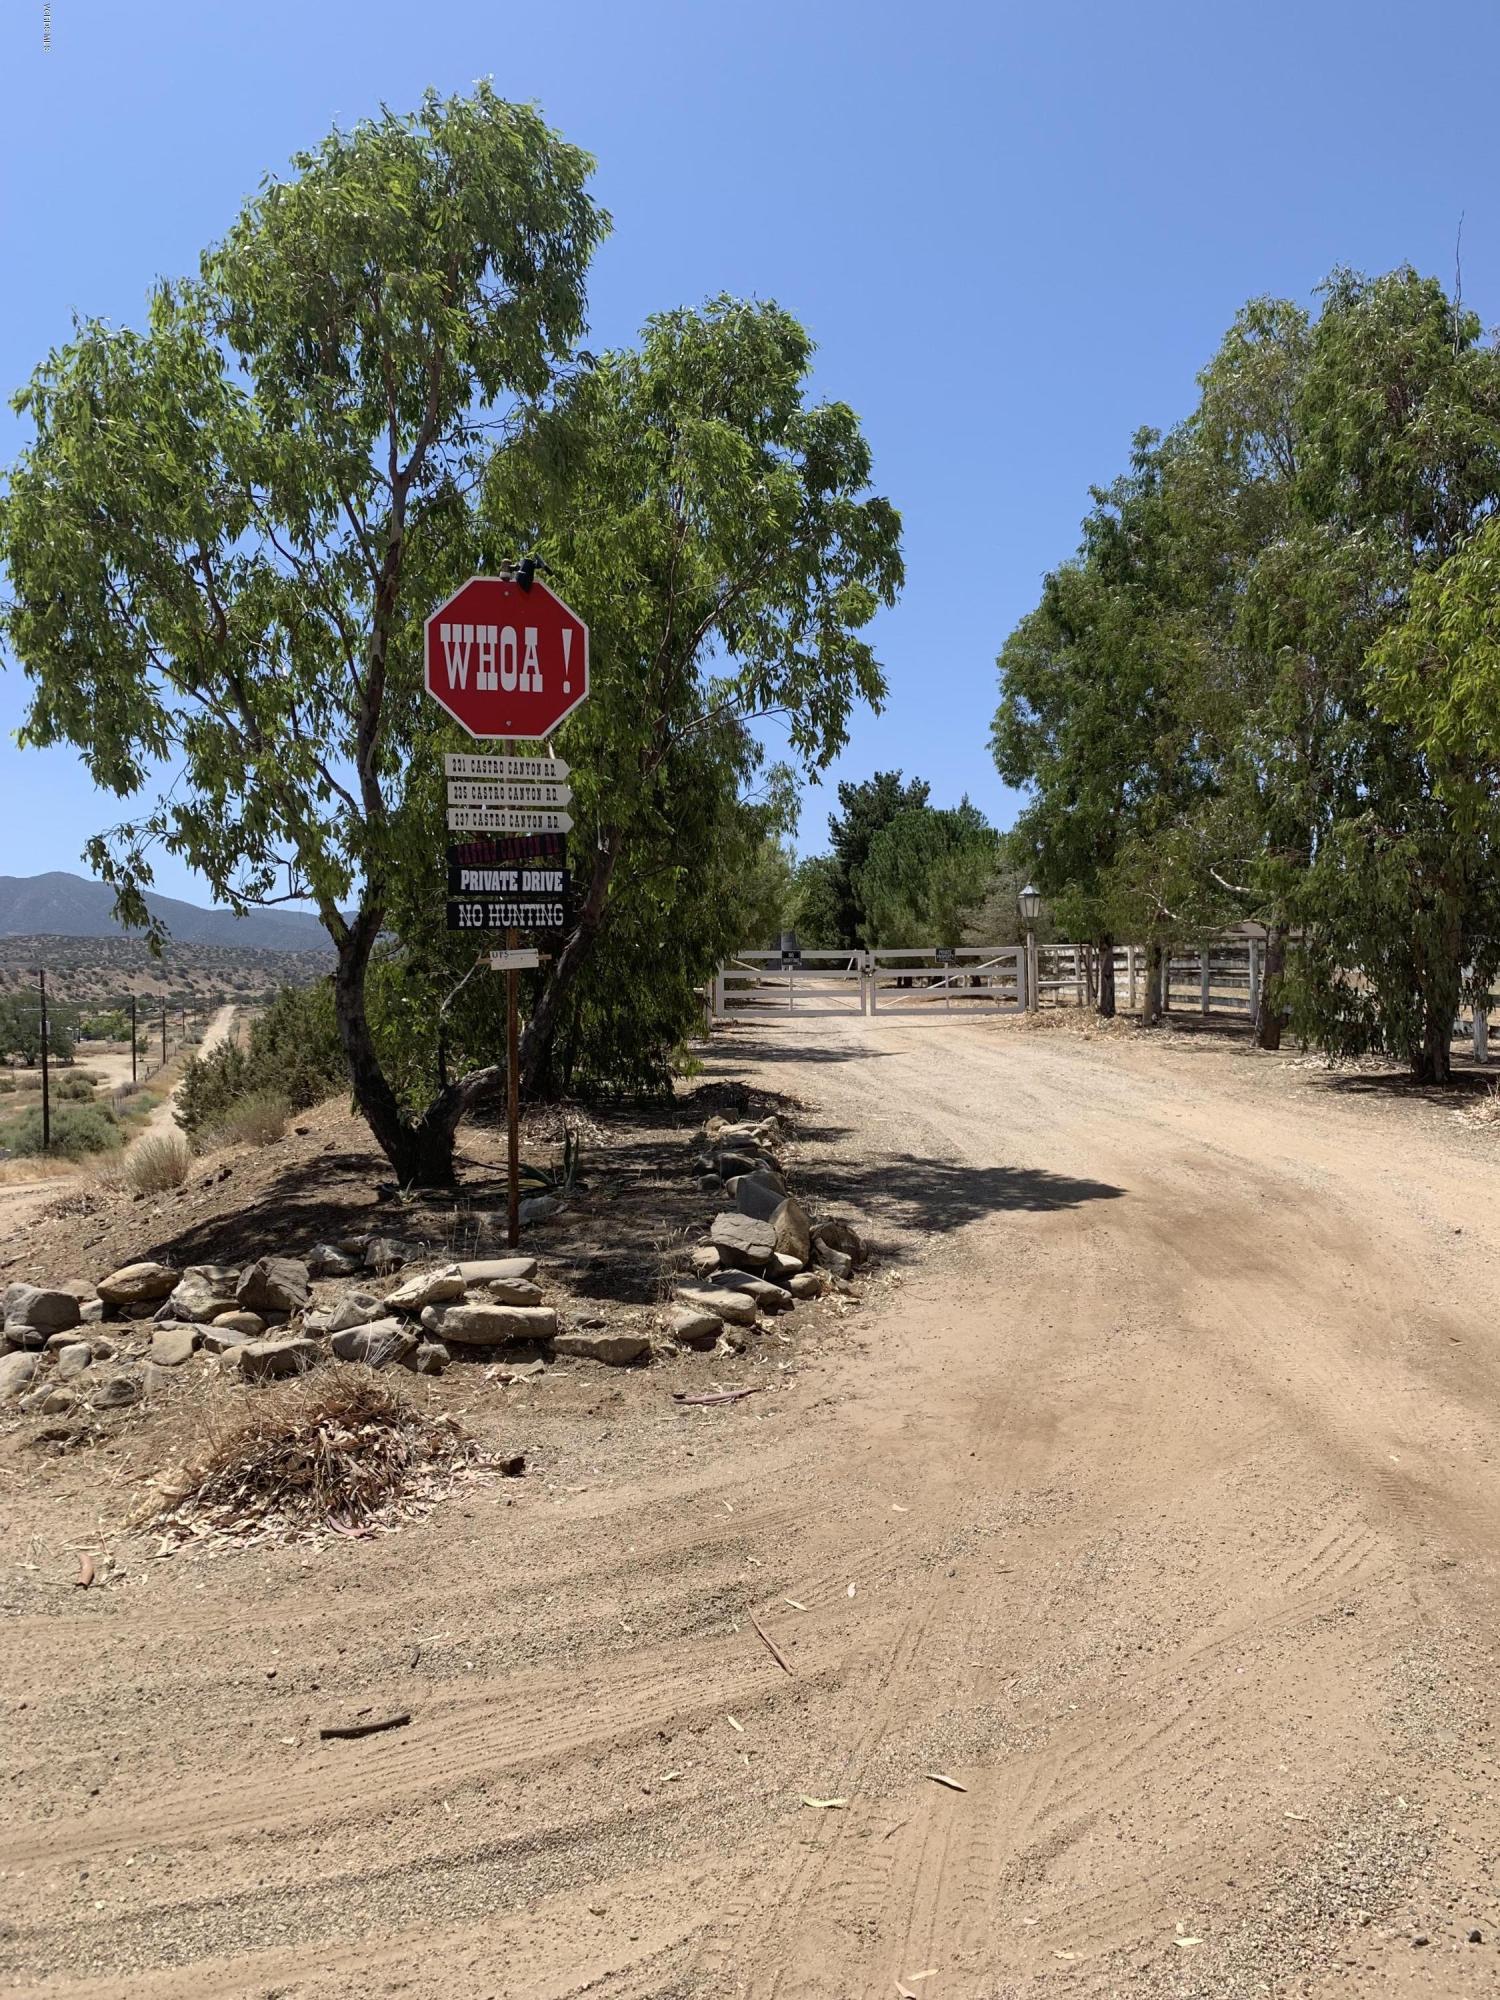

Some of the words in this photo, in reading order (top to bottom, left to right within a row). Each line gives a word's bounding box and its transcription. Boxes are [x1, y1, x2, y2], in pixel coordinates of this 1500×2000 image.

[440, 623, 543, 693] WHOA
[561, 628, 573, 694] !
[452, 758, 466, 772] 231
[471, 759, 504, 774] CASTRO
[508, 761, 541, 776] CANYON
[544, 763, 557, 777] RD.
[454, 785, 468, 800] 235
[471, 786, 505, 800] CASTRO
[508, 786, 542, 800] CANYON
[546, 788, 559, 801] RD.
[455, 812, 469, 827] 237
[472, 812, 506, 827] CASTRO
[509, 814, 543, 828] CANYON
[547, 815, 560, 829] RD.
[460, 869, 519, 891] PRIVATE
[521, 870, 564, 892] DRIVE
[458, 903, 484, 927] NO
[487, 903, 565, 926] HUNTING
